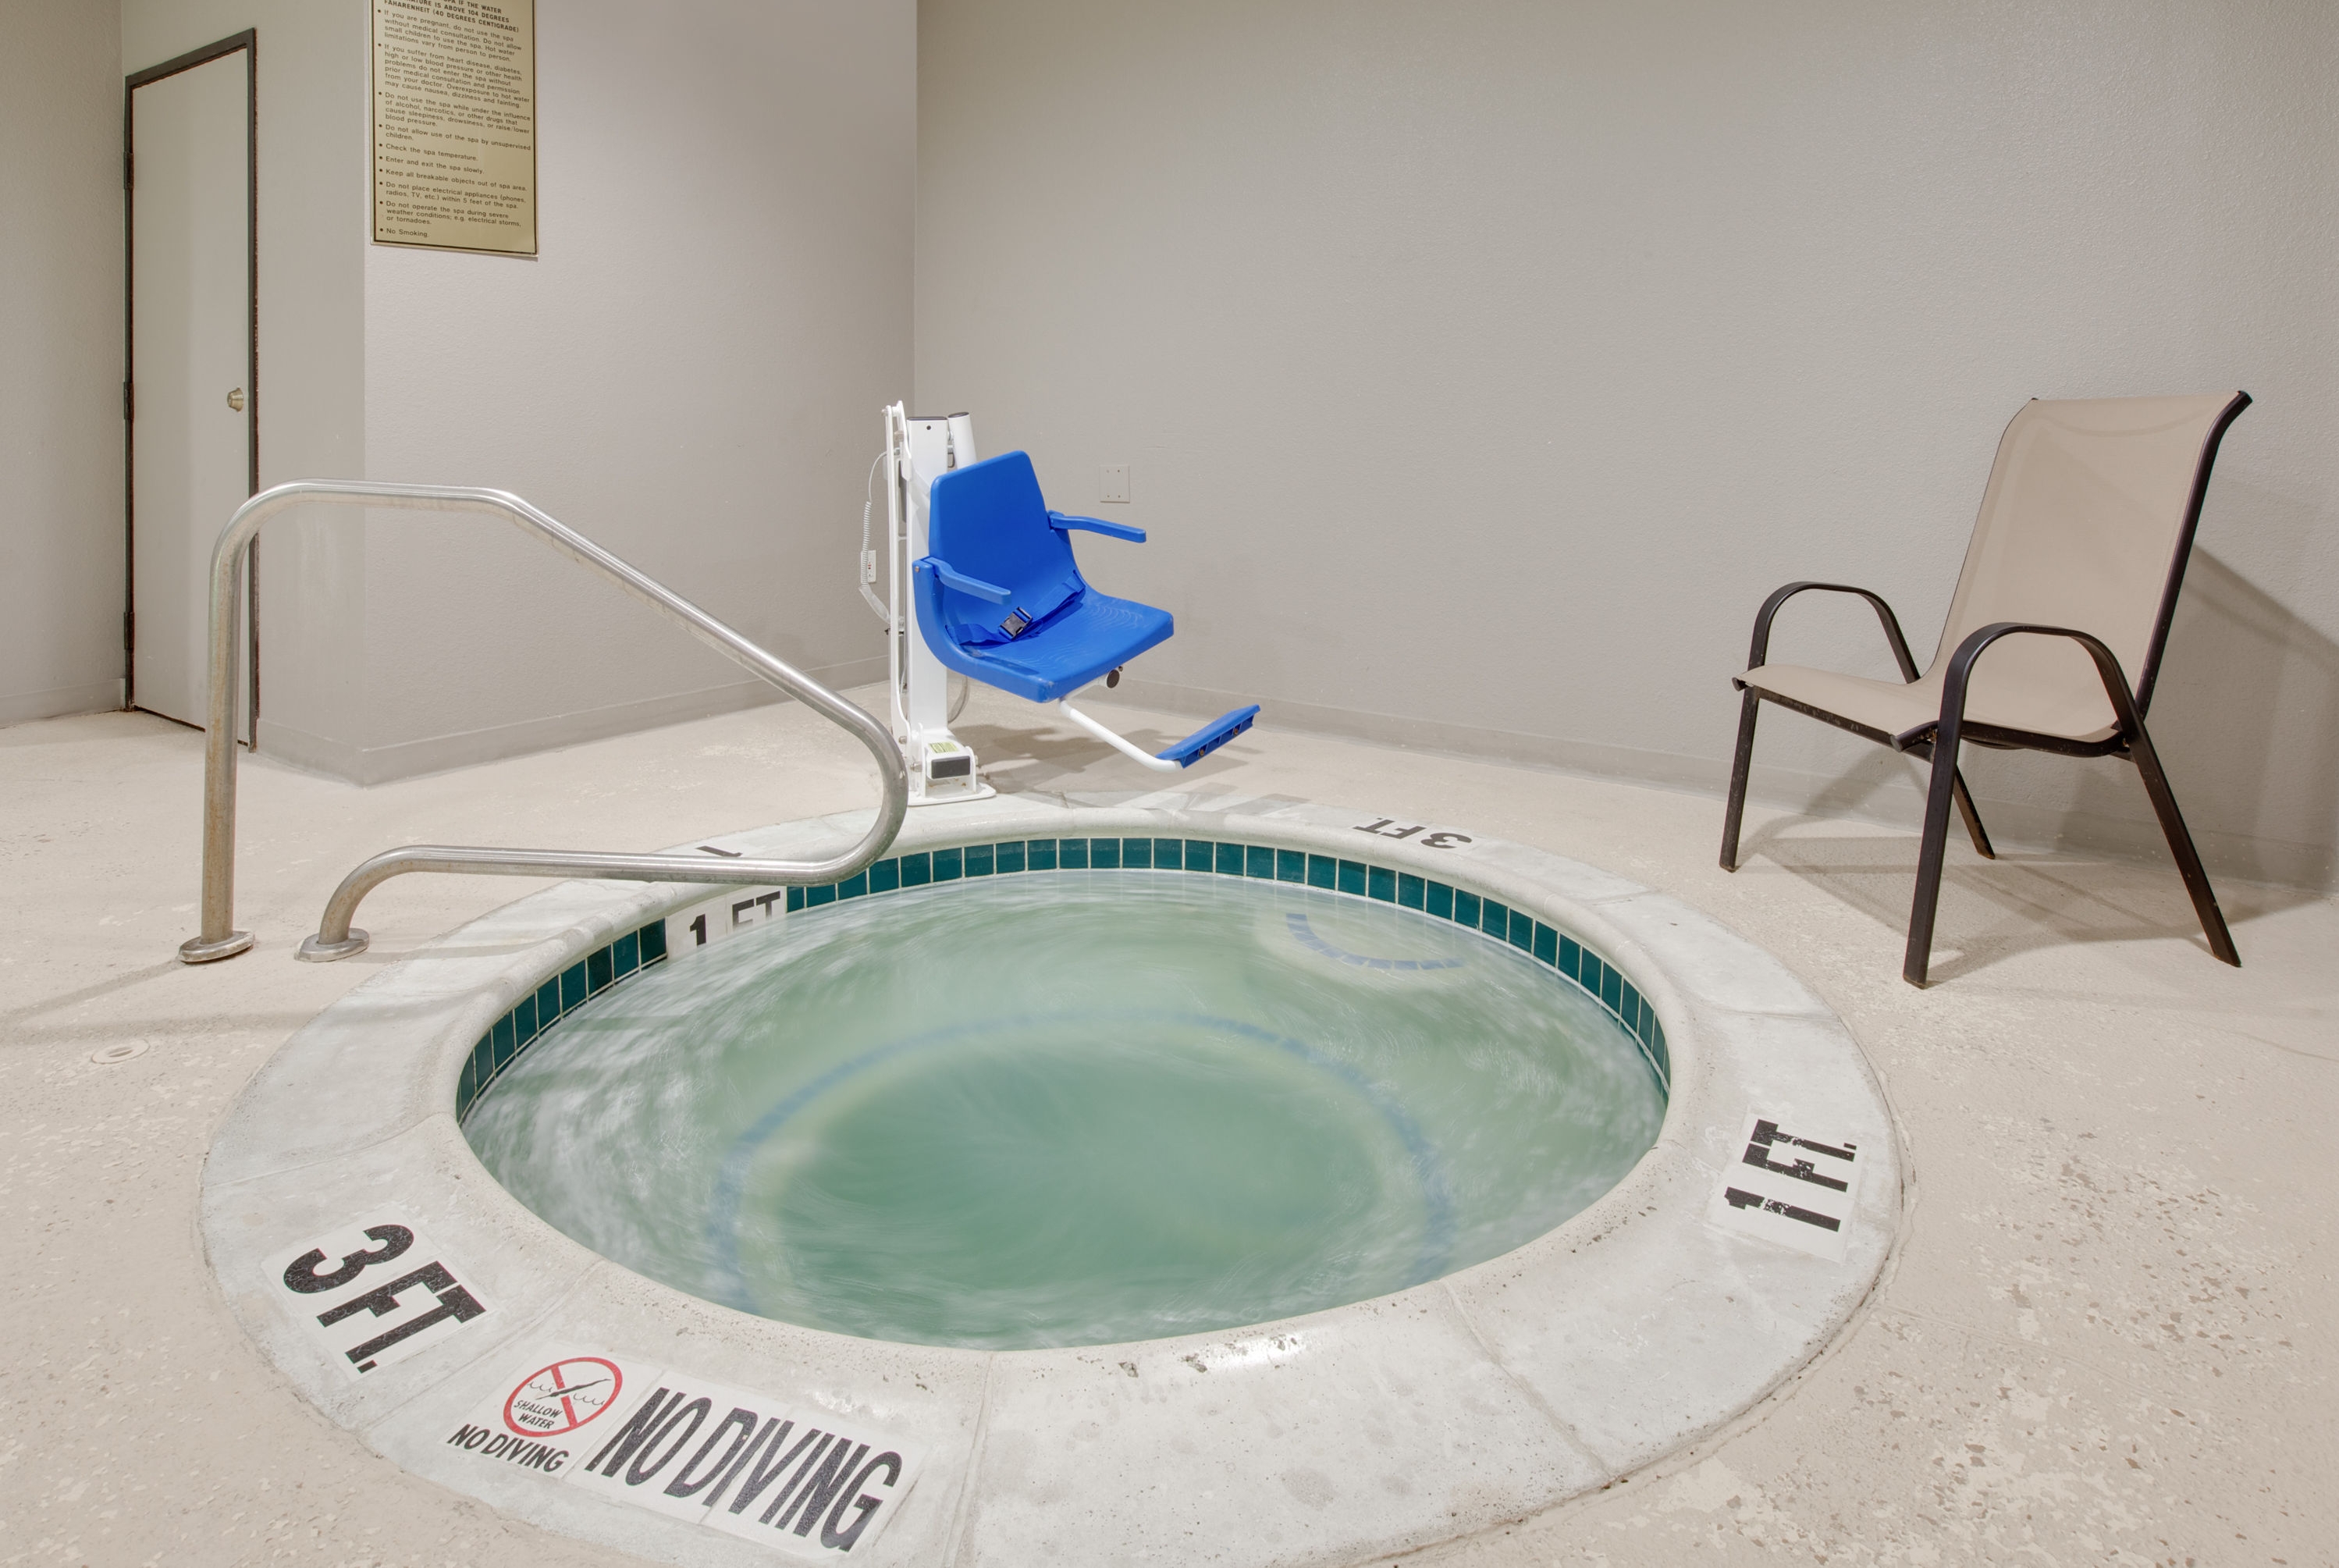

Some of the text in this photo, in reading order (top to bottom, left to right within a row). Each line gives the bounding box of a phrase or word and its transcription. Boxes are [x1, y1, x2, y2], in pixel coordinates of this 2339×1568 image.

[384, 0, 429, 13] FAHARENHEIT
[446, 12, 475, 23] DEGREES
[478, 19, 518, 33] CENTIGRADE)
[444, 4, 464, 13] ABOVE
[481, 12, 509, 23] DEGREES
[481, 5, 501, 14] WATER
[384, 19, 409, 27] without
[412, 24, 437, 33] medical
[384, 31, 418, 43] limitations
[405, 30, 431, 38] children
[385, 59, 415, 69] problems
[446, 63, 473, 72] pressure
[403, 69, 428, 78] medical
[432, 75, 471, 85] consultation
[487, 85, 520, 94] permission
[446, 84, 489, 95] Overexposure
[452, 91, 480, 101] dizziness
[503, 112, 530, 120] influence
[491, 140, 531, 150] unsupervised
[386, 169, 403, 177] Keep
[416, 172, 448, 181] breakable
[1420, 832, 1473, 849] 3
[689, 913, 706, 946] 1
[1723, 1186, 1841, 1232] 1
[283, 1224, 415, 1294] 3
[514, 1399, 563, 1419] SHALLOW
[517, 1413, 555, 1431] WATER
[447, 1424, 571, 1474] NO DIVING
[585, 1386, 904, 1552] NO DIVING
